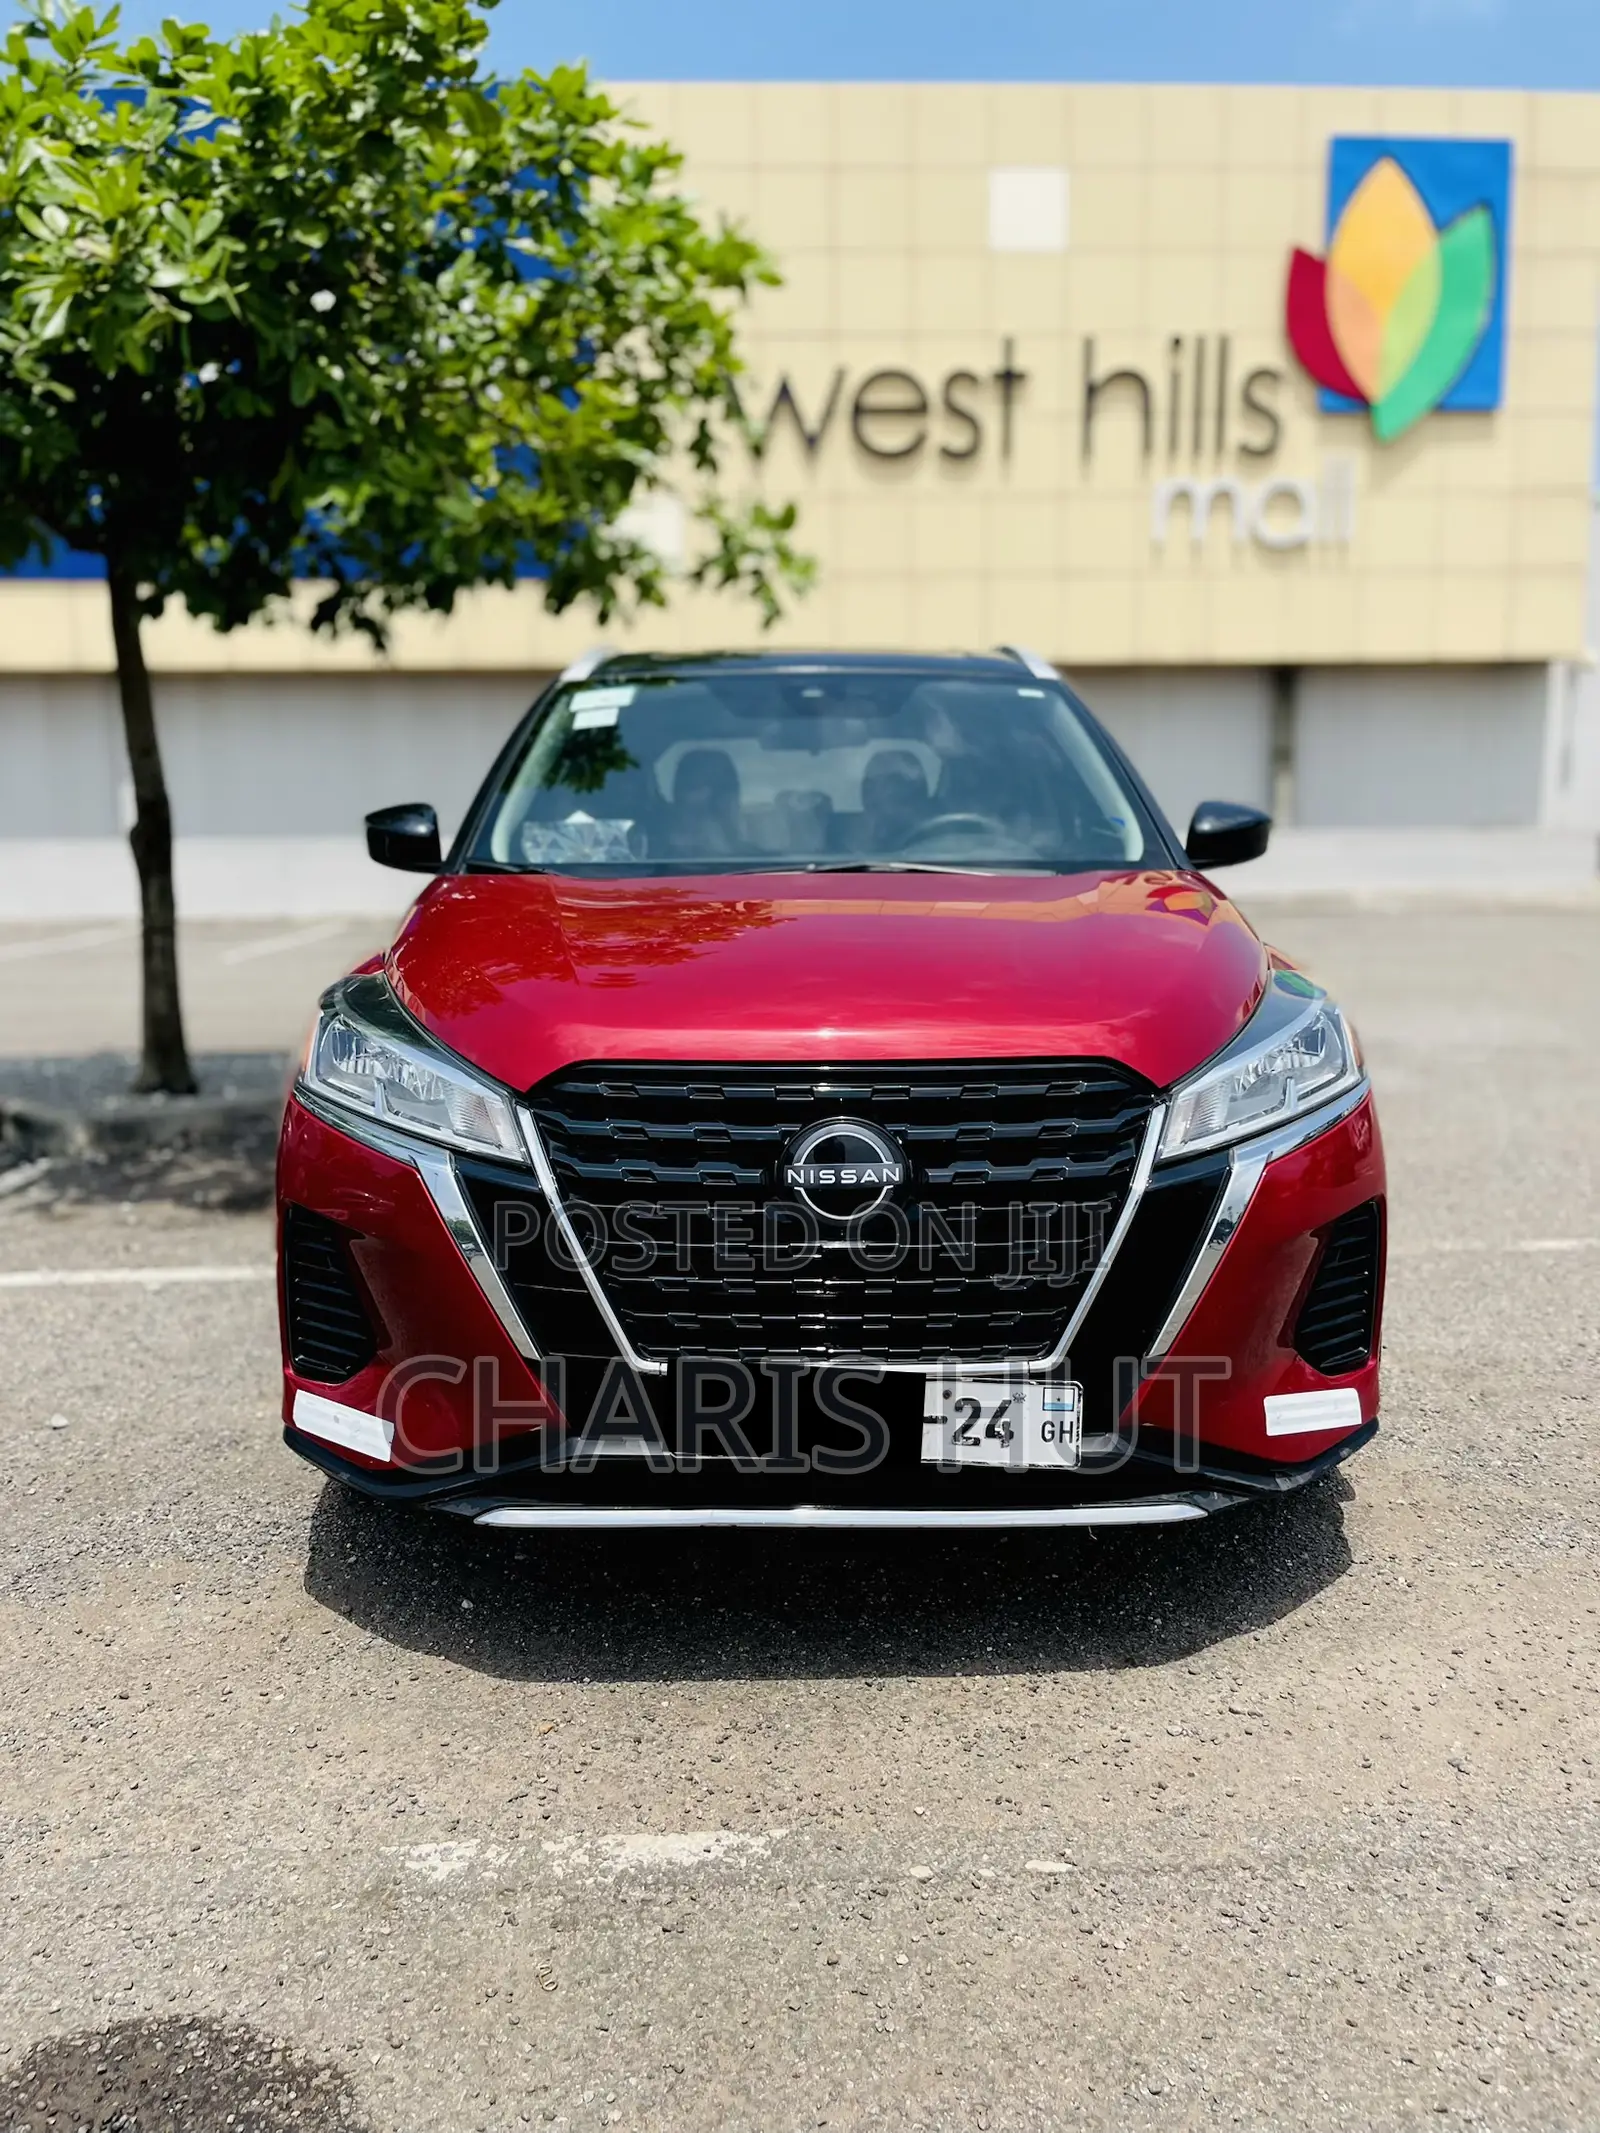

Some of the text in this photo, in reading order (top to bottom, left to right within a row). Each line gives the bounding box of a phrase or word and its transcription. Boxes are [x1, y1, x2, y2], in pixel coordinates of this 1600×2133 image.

[720, 333, 1284, 462] west hills
[1152, 455, 1357, 549] mall
[787, 1166, 901, 1185] NISSAN
[1041, 1420, 1075, 1444] GH
